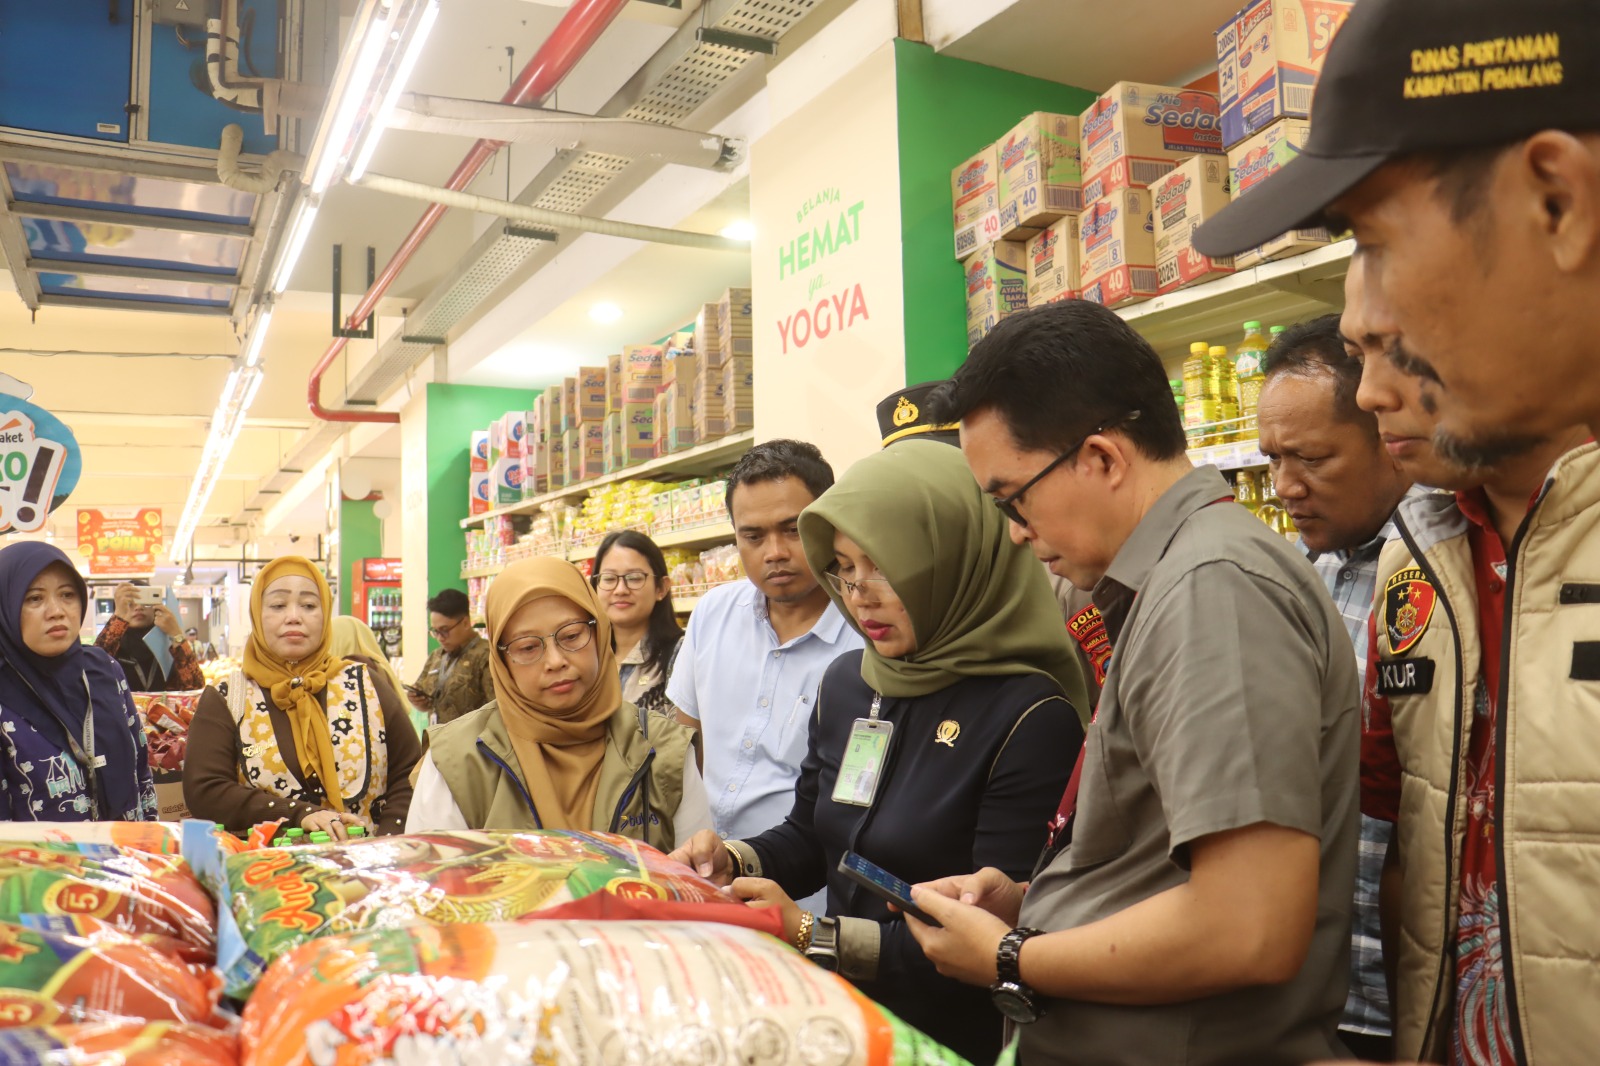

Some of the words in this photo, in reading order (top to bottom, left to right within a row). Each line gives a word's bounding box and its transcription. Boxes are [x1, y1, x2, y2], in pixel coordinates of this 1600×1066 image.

[1411, 45, 1460, 73] DINAS
[1156, 94, 1181, 105] Mie
[1110, 161, 1122, 184] 40
[797, 186, 841, 223] BELANJA
[1022, 186, 1037, 207] 40
[984, 215, 998, 234] 40
[779, 200, 865, 280] HEMAT
[1112, 248, 1119, 261] 8
[1108, 269, 1123, 291] 40
[777, 283, 870, 355] YOGYA
[1382, 663, 1416, 688] KUR
[69, 888, 99, 910] 5
